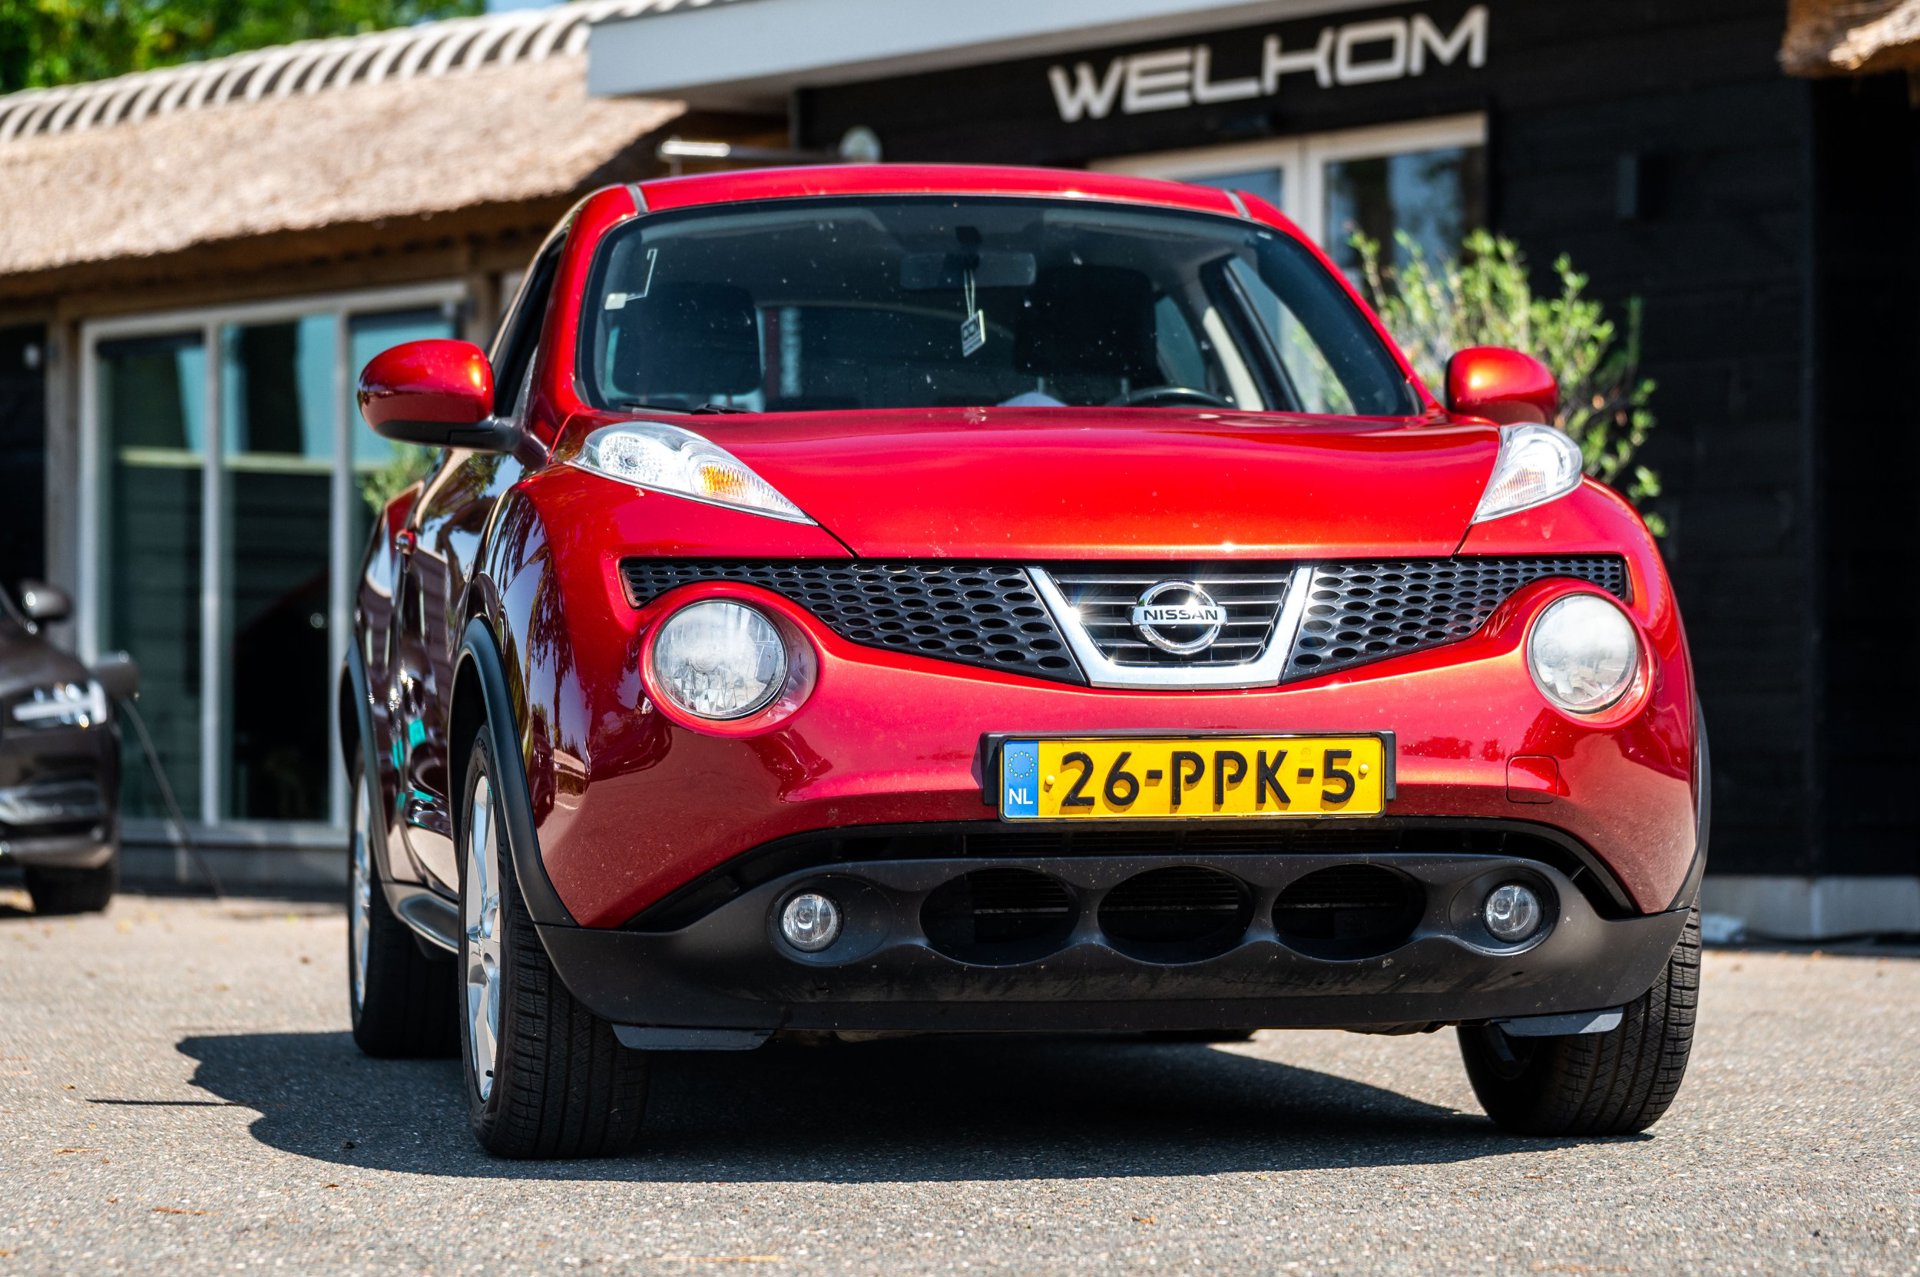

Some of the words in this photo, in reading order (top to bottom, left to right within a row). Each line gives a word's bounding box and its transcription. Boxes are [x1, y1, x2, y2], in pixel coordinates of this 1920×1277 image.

[1049, 5, 1488, 122] WELKOM
[1144, 609, 1218, 621] NISSAN
[1060, 750, 1356, 807] 26-PPK-5
[1008, 789, 1034, 805] NL
